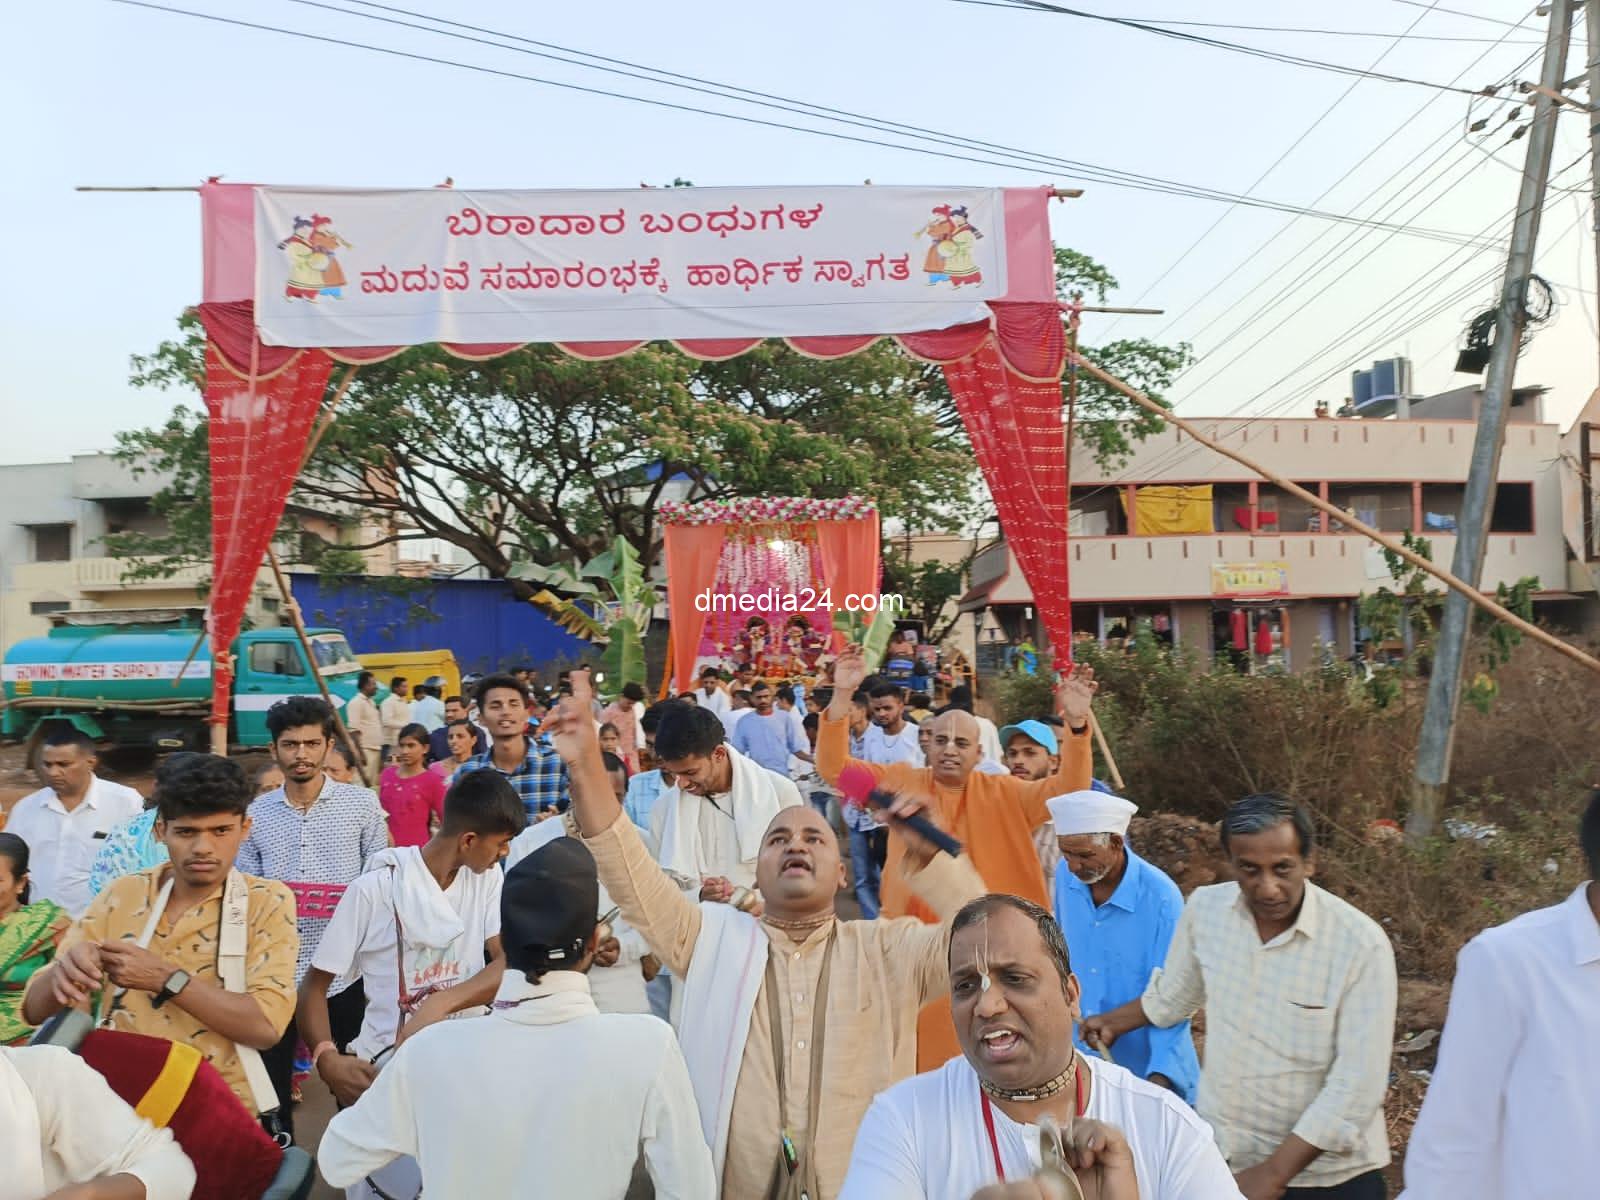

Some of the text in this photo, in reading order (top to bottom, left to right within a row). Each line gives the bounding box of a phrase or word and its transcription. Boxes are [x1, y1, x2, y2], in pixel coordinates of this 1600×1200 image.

[446, 203, 824, 239] ಬಿರಾದಾರ ಬಂಧುಗಳ
[360, 261, 470, 295] ಮದುವೆ
[479, 257, 669, 293] ಸಮಾರಂಭಕ್ಕೆ
[814, 253, 911, 288] ಸ್ವಾಗತ
[62, 664, 105, 679] WATER
[112, 663, 161, 678] SUPPLY
